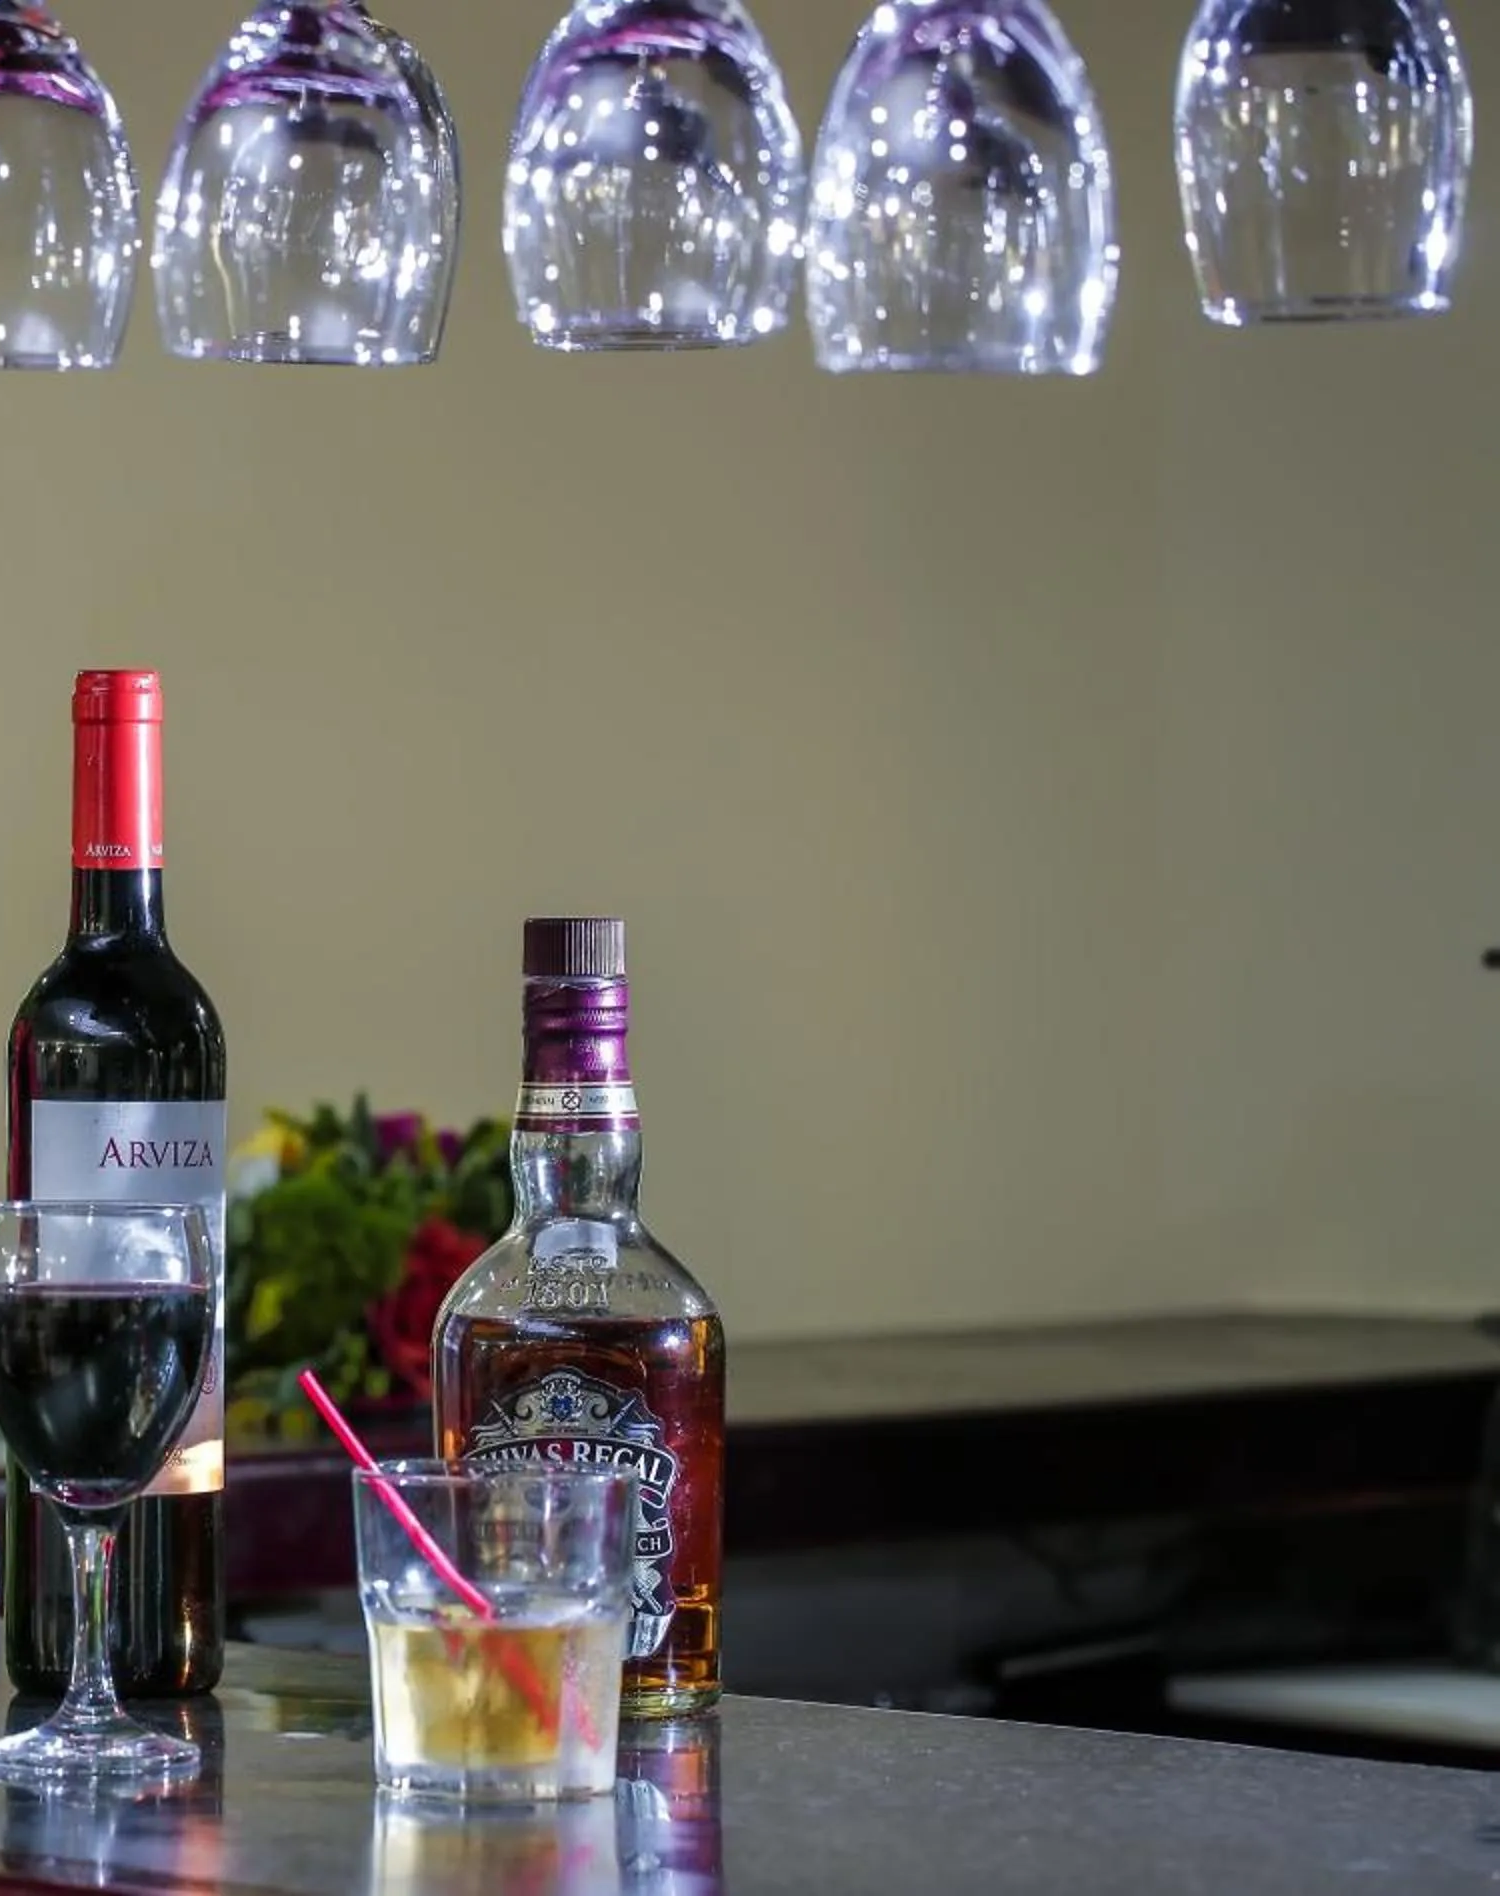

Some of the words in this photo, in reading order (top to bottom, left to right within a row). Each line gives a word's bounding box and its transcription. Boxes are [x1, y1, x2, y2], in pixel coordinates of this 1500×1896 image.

[84, 841, 132, 857] ARVIZA
[99, 1136, 214, 1168] ARVIZA
[469, 1443, 565, 1466] IVAS
[572, 1441, 665, 1485] REGAL
